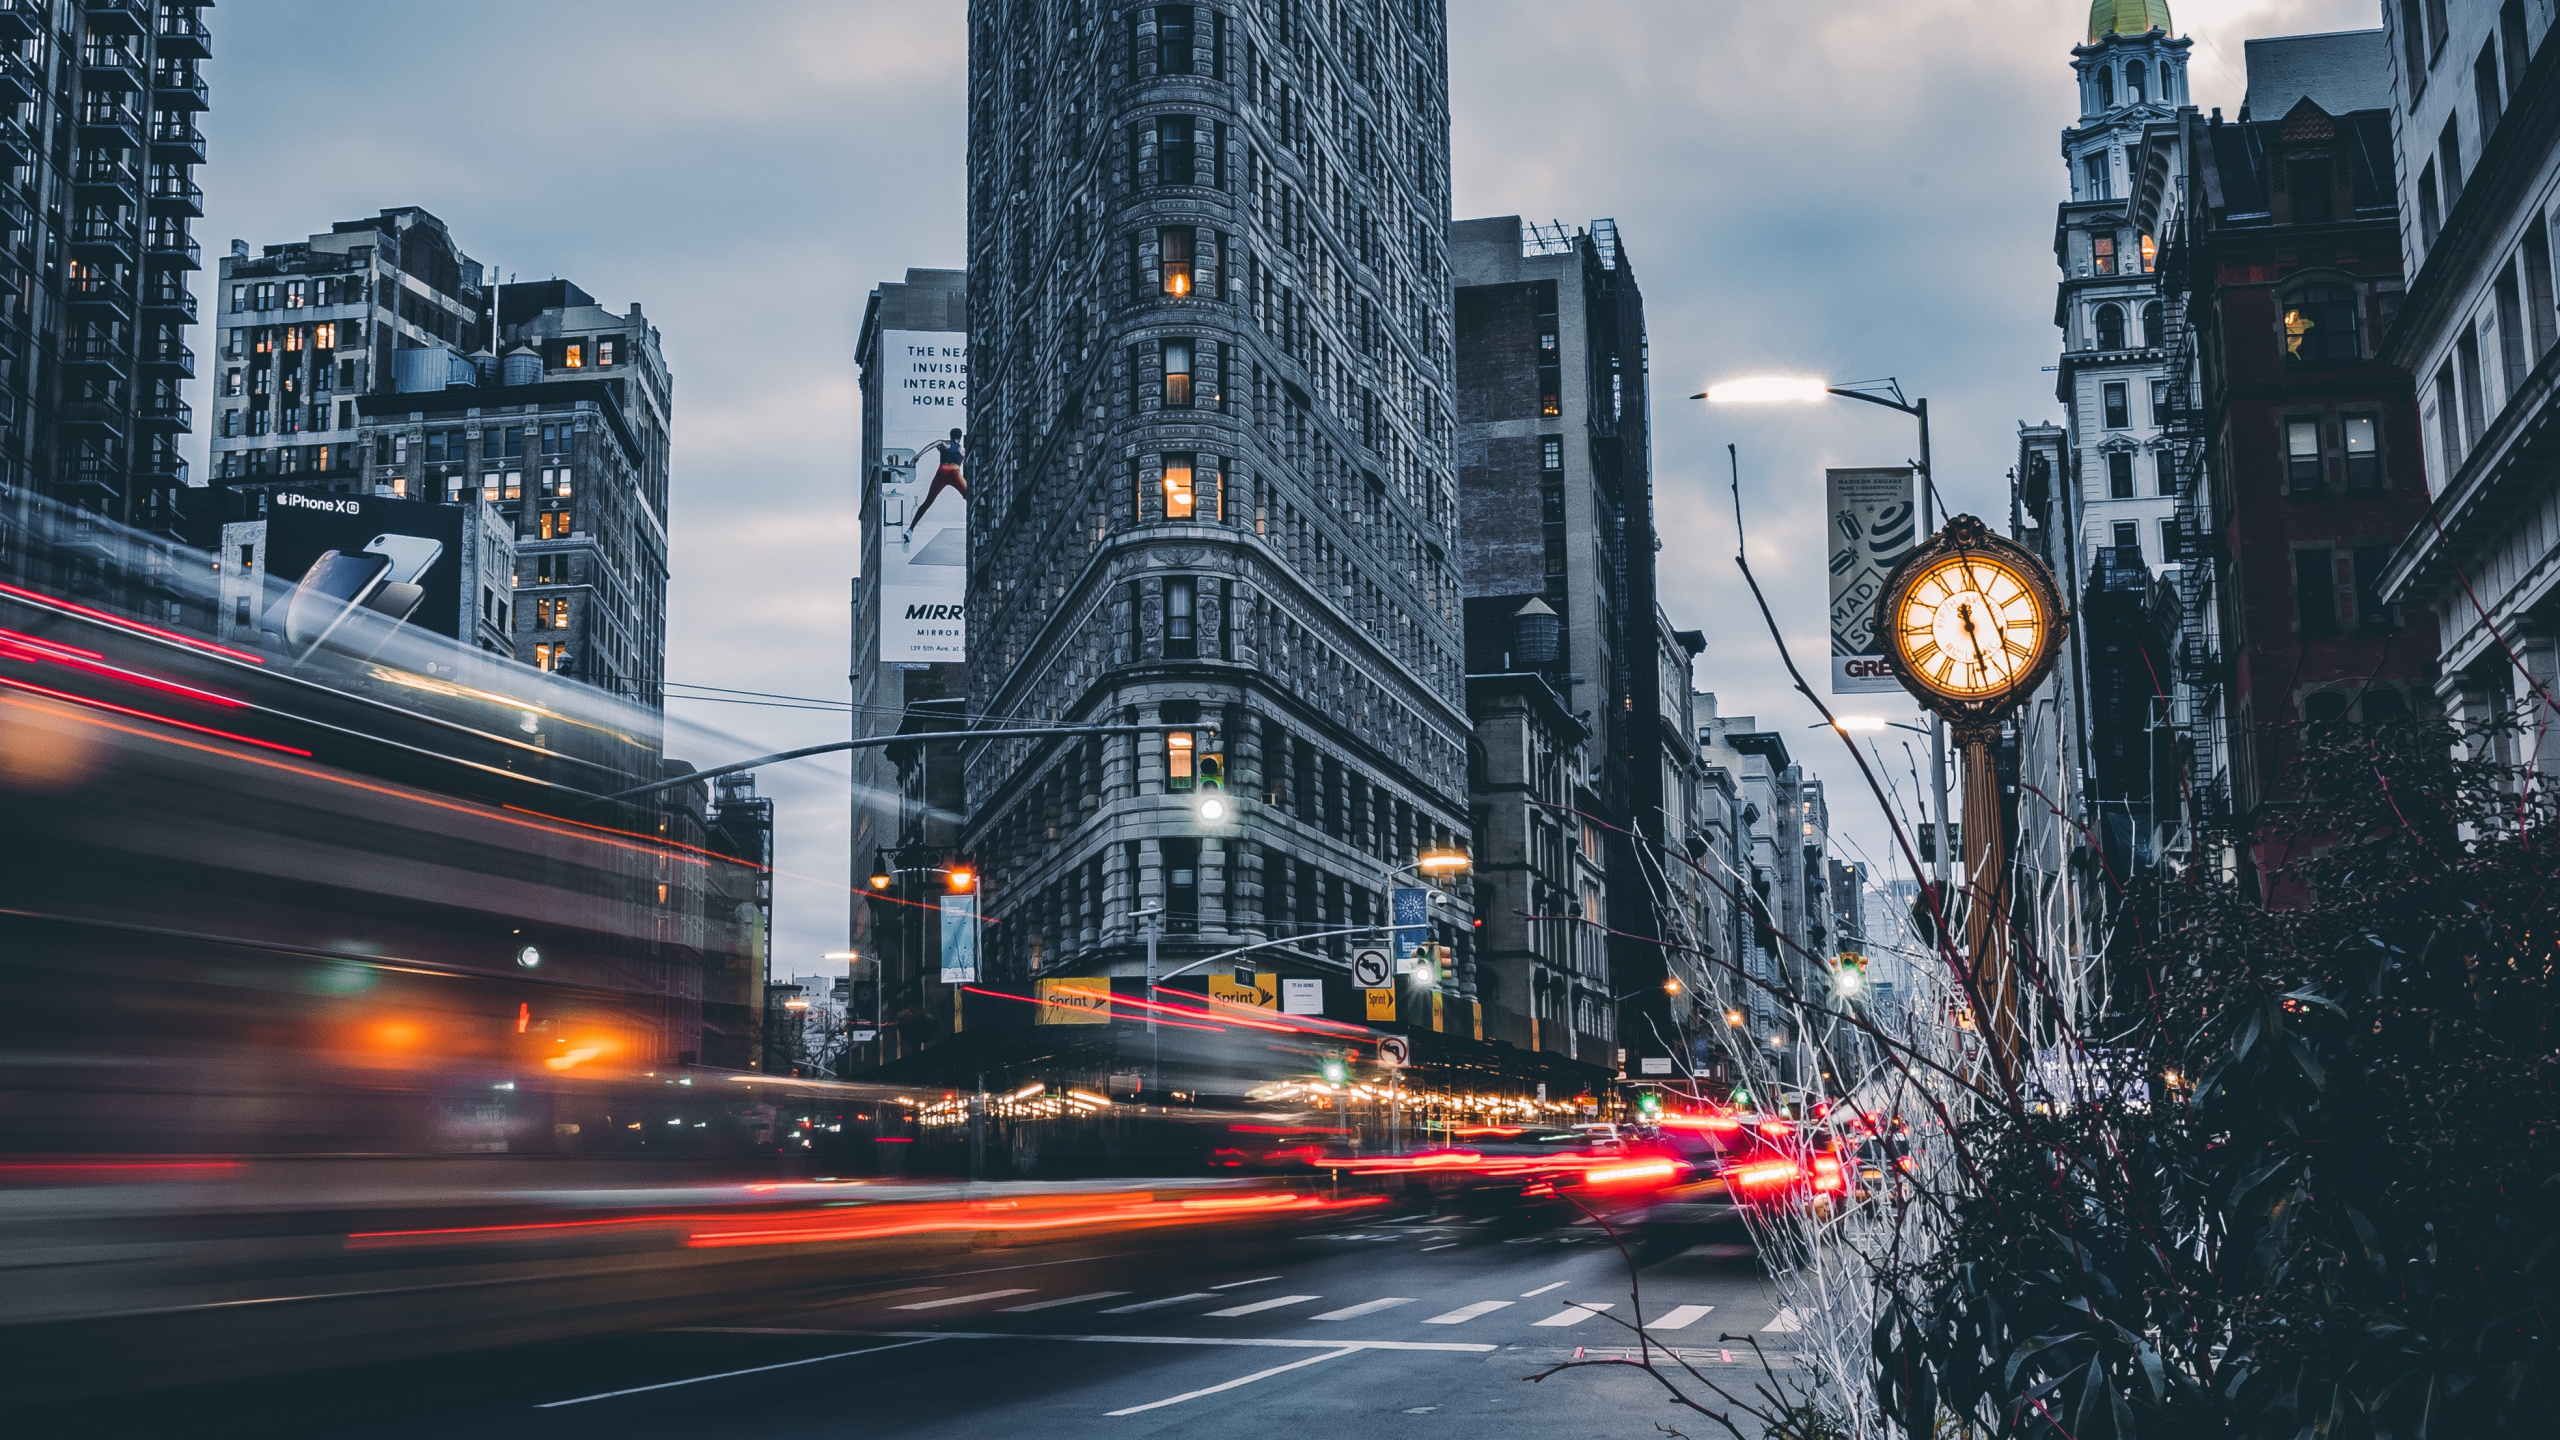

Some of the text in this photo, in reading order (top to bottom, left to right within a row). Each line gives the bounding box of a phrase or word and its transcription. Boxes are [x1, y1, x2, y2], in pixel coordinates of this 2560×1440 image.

[908, 346, 935, 356] THE
[913, 363, 968, 374] INVISIB
[904, 379, 966, 390] INTERAC
[912, 395, 955, 407] HOME
[288, 493, 334, 511] iPhone
[905, 604, 964, 620] MIRR
[1830, 583, 1880, 627] MAD.
[1048, 995, 1087, 1010] Sprint
[1214, 991, 1254, 1007] Sprint
[1369, 993, 1386, 1007] Sprint
